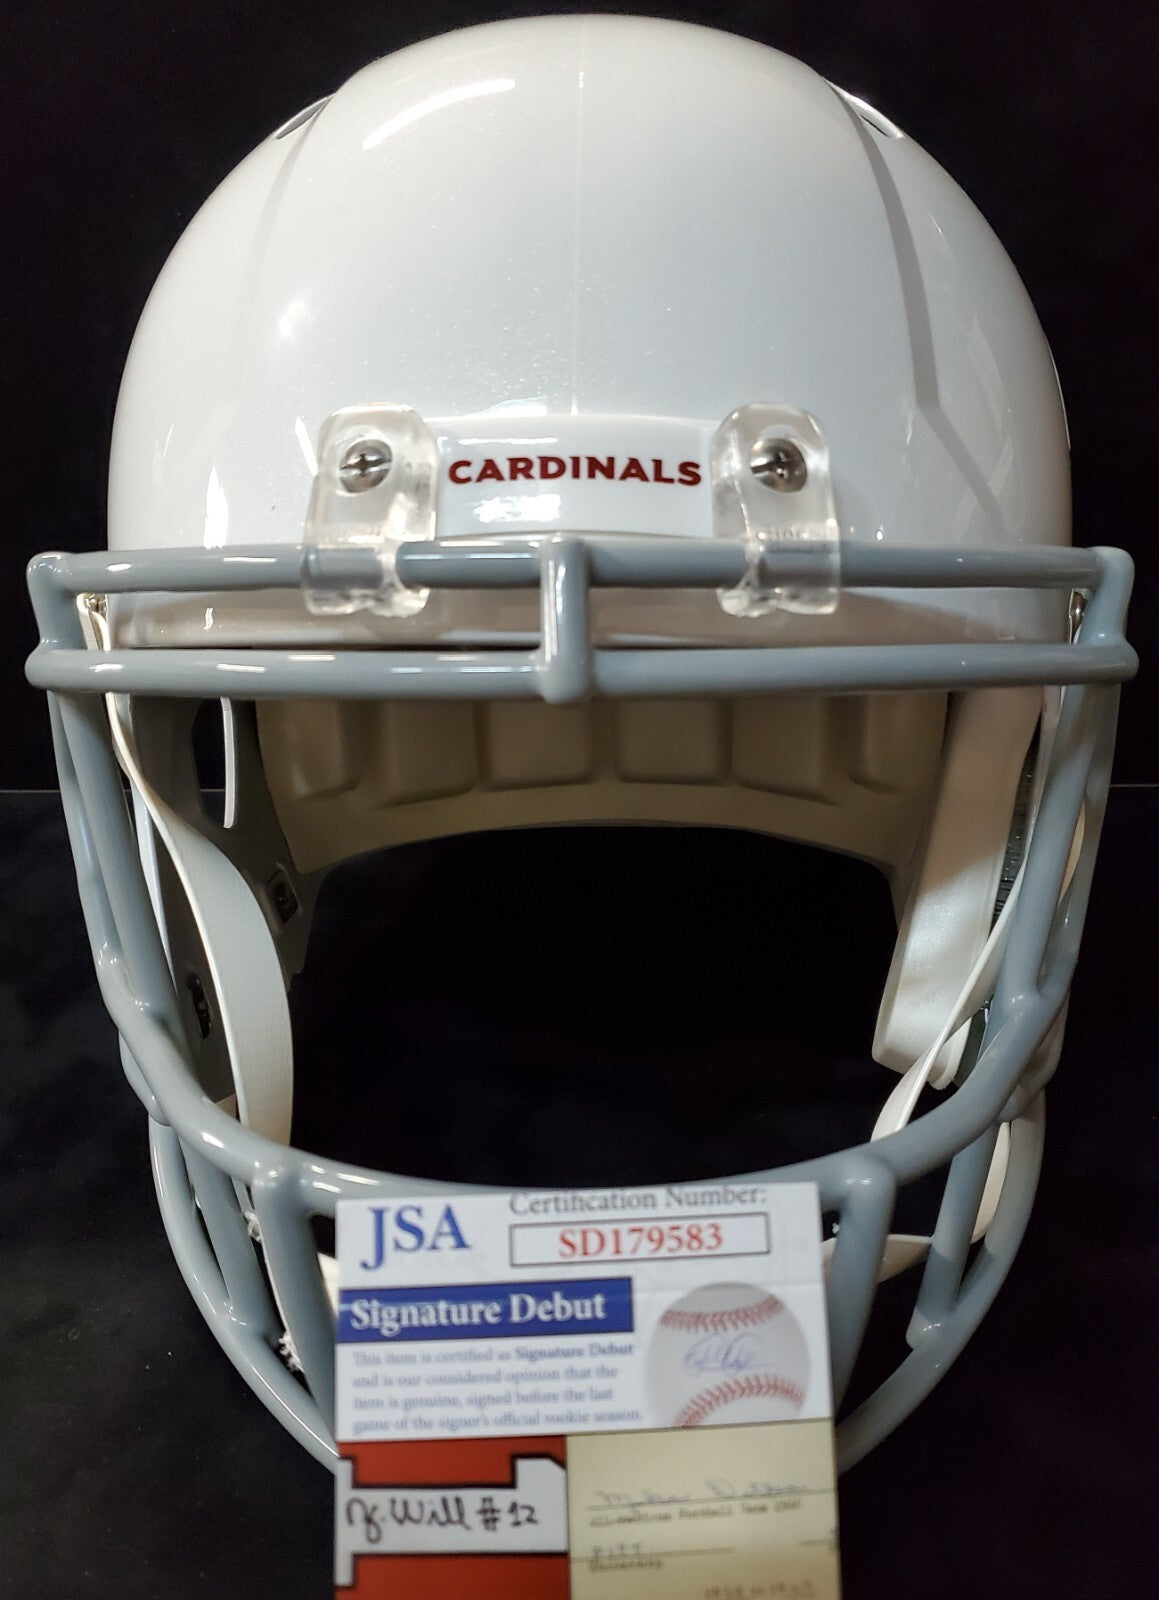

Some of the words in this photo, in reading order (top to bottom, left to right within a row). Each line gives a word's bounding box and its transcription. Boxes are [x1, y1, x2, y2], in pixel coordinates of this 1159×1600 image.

[448, 456, 702, 486] CARDINALS
[509, 1188, 657, 1216] Certification
[665, 1185, 767, 1208] Number:
[360, 1203, 472, 1271] JSA
[559, 1222, 724, 1259] SD179583
[350, 1299, 502, 1337] Signature
[509, 1291, 607, 1324] Debut
[353, 1350, 382, 1366] This
[386, 1351, 417, 1364] item
[421, 1351, 433, 1363] is
[436, 1347, 493, 1363] certified
[498, 1350, 512, 1361] as
[514, 1345, 585, 1363] Signature
[588, 1341, 634, 1356] Debut
[353, 1372, 379, 1387] and
[384, 1375, 394, 1386] is
[398, 1375, 421, 1386] our
[426, 1370, 501, 1385] considered
[506, 1369, 560, 1384] opinion
[565, 1364, 591, 1379] that
[596, 1363, 618, 1378] the
[353, 1396, 384, 1409] item
[389, 1396, 399, 1408] is
[466, 1391, 512, 1408] signed
[516, 1389, 560, 1403] before
[564, 1386, 586, 1401] the
[590, 1385, 613, 1400] last
[353, 1419, 389, 1434] game
[394, 1415, 409, 1429] of
[413, 1415, 434, 1429] the
[495, 1410, 540, 1425] official
[545, 1409, 590, 1424] rookie
[594, 1408, 643, 1421] season.
